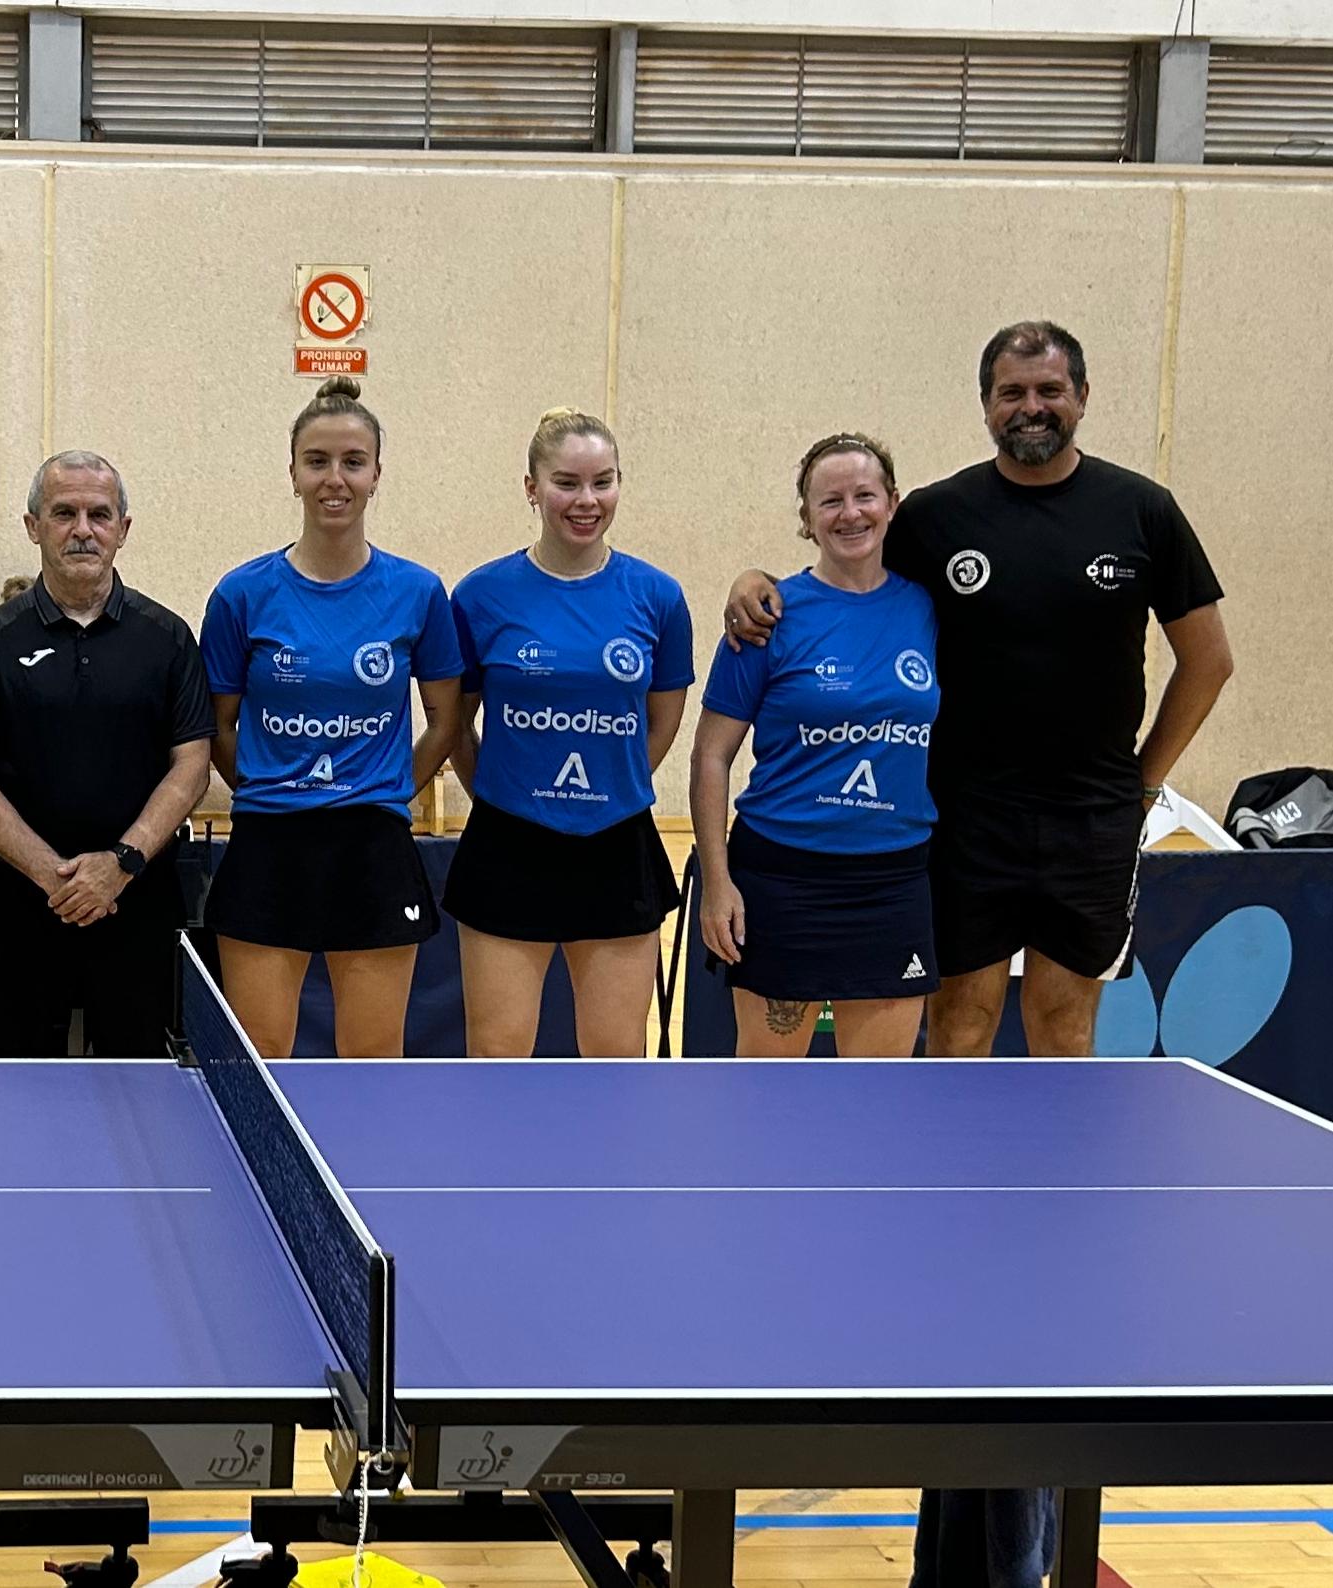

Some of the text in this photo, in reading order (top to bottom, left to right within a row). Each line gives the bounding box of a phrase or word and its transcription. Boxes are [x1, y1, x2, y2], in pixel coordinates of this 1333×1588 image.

[300, 351, 362, 361] PROHIBIDO
[311, 362, 351, 372] FUMAR
[531, 788, 555, 798] Junta
[557, 790, 567, 799] de
[816, 794, 841, 805] Junta
[843, 797, 854, 806] de
[95, 1474, 164, 1486] PONGORI
[541, 1473, 626, 1486] TTT 930
